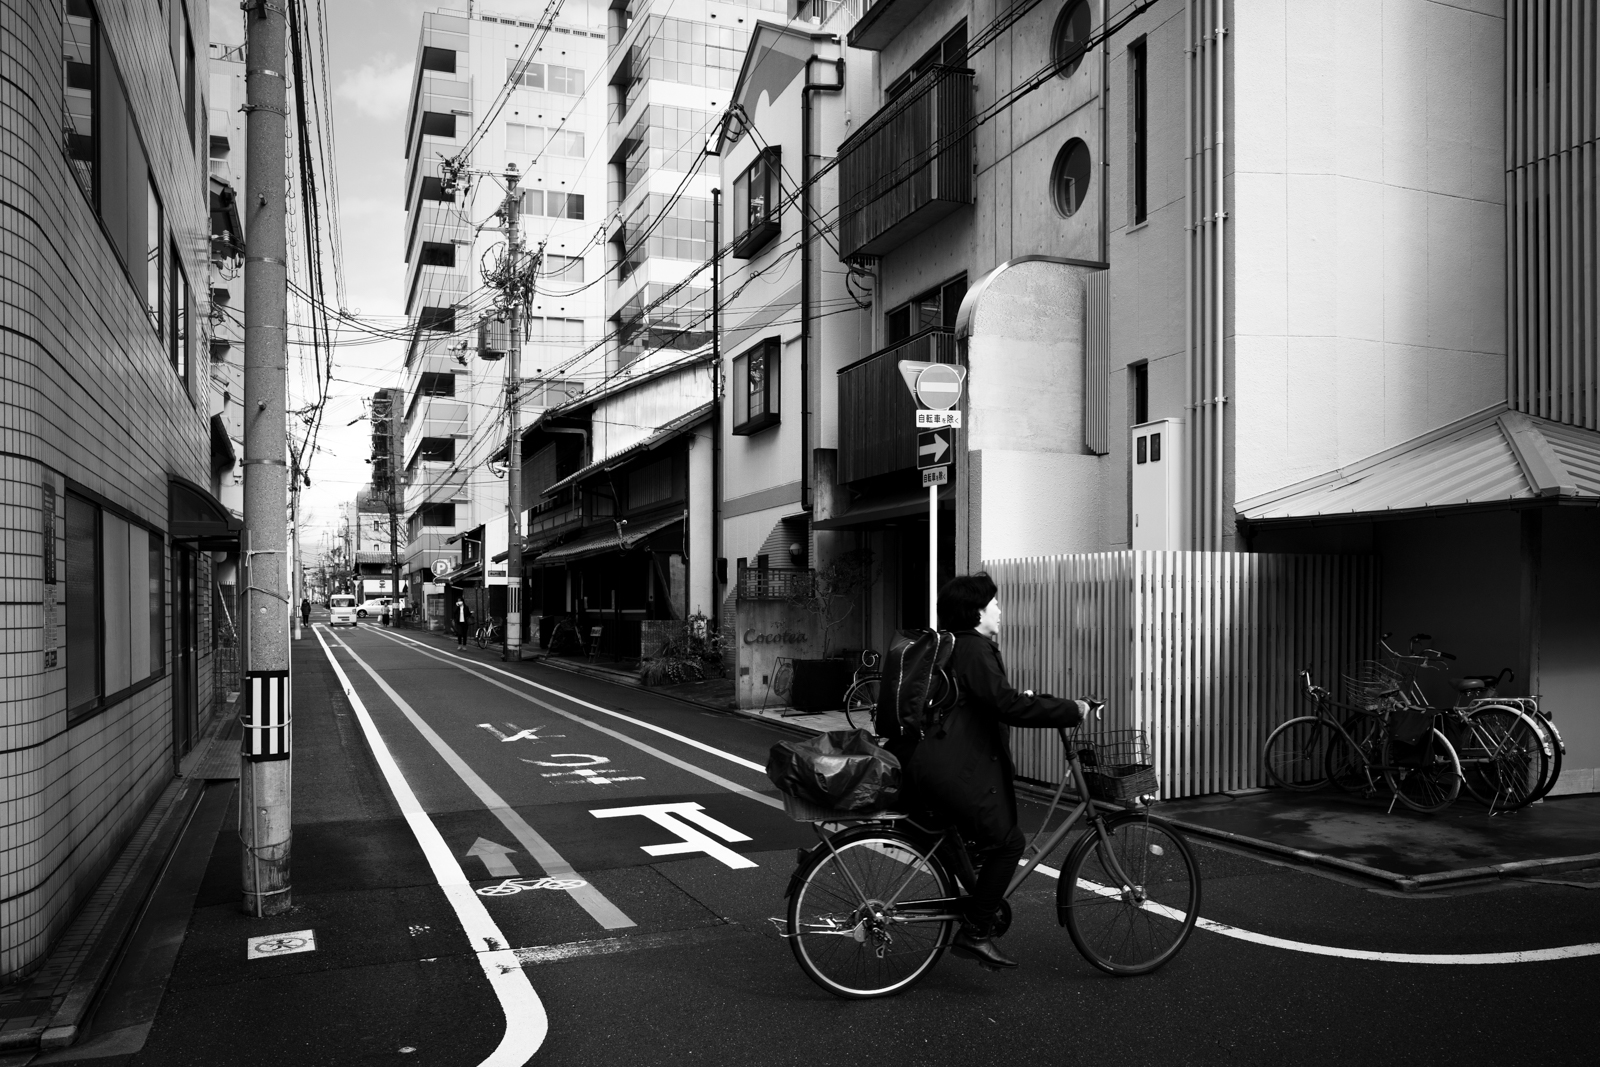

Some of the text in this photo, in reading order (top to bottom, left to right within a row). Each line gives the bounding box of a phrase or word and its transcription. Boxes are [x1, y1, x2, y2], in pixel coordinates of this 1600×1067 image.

[918, 414, 959, 423] 自転車を除く
[923, 471, 946, 483] 自転車を除く
[436, 561, 447, 575] P
[744, 628, 808, 645] Cocotea
